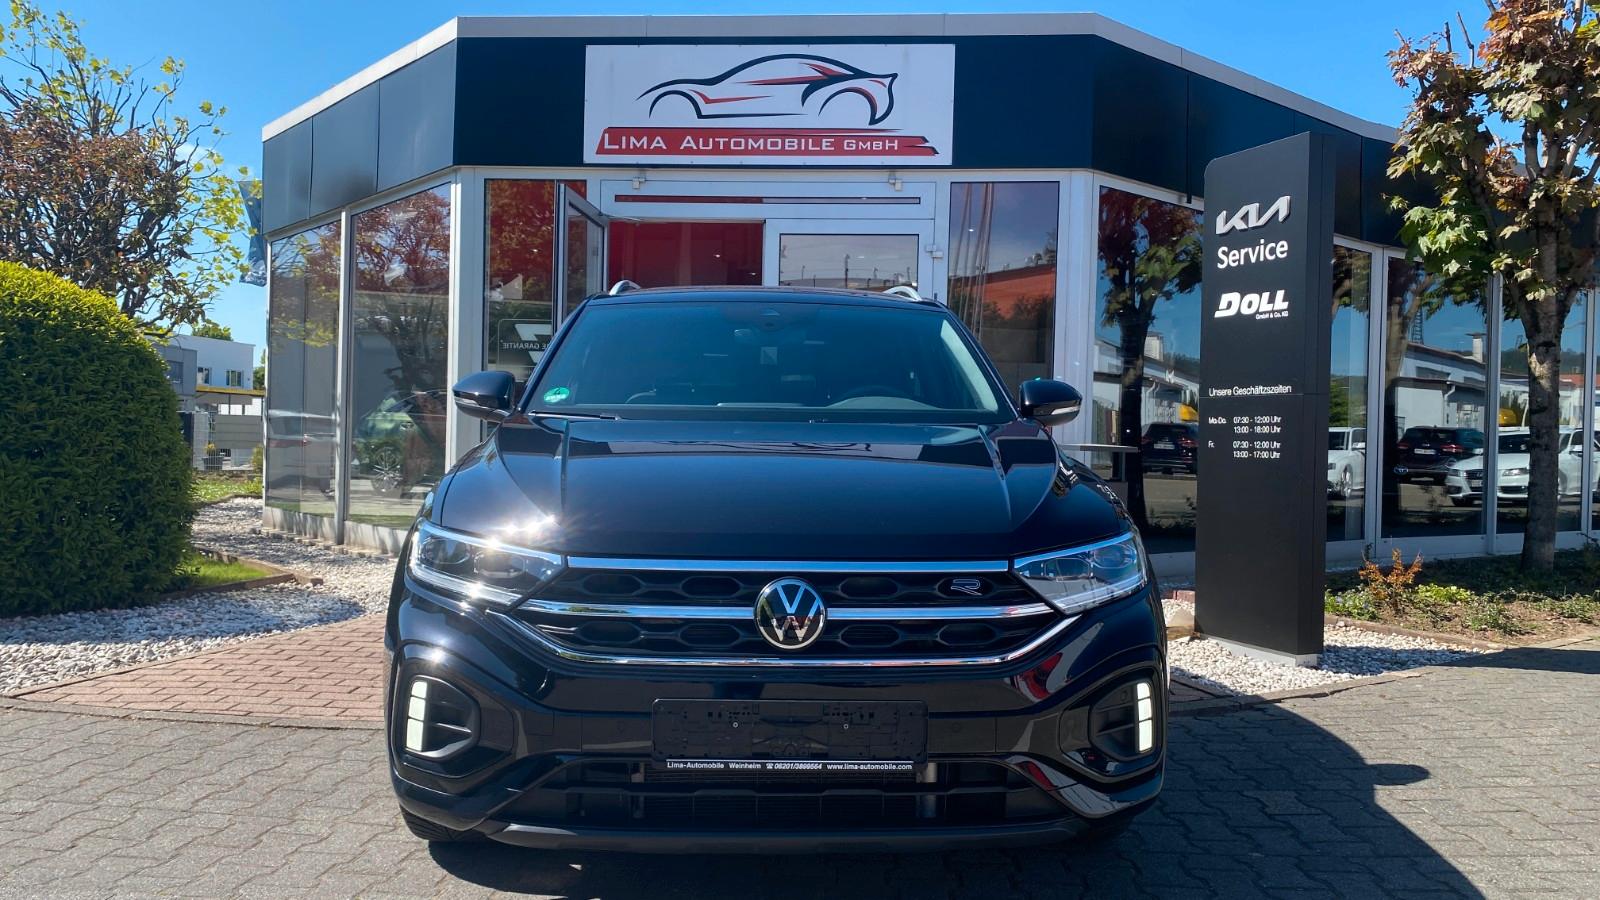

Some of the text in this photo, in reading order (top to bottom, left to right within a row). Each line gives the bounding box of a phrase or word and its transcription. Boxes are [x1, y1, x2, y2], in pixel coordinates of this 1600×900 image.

[1215, 195, 1291, 235] KIA
[1217, 239, 1288, 269] Service
[1214, 289, 1289, 318] DOLL
[1208, 388, 1232, 397] Unsere
[1233, 416, 1250, 424] 07:30
[1254, 415, 1271, 423] 12:00
[1270, 415, 1282, 423] Uhr
[1270, 425, 1282, 433] Uhr
[1232, 441, 1249, 449] 07:30
[1253, 441, 1271, 449] 12:00
[1270, 441, 1282, 449] Uhr
[1253, 451, 1270, 459] 17:00
[1269, 451, 1281, 459] Uhr
[826, 763, 913, 771] www.lima-automobile.com
